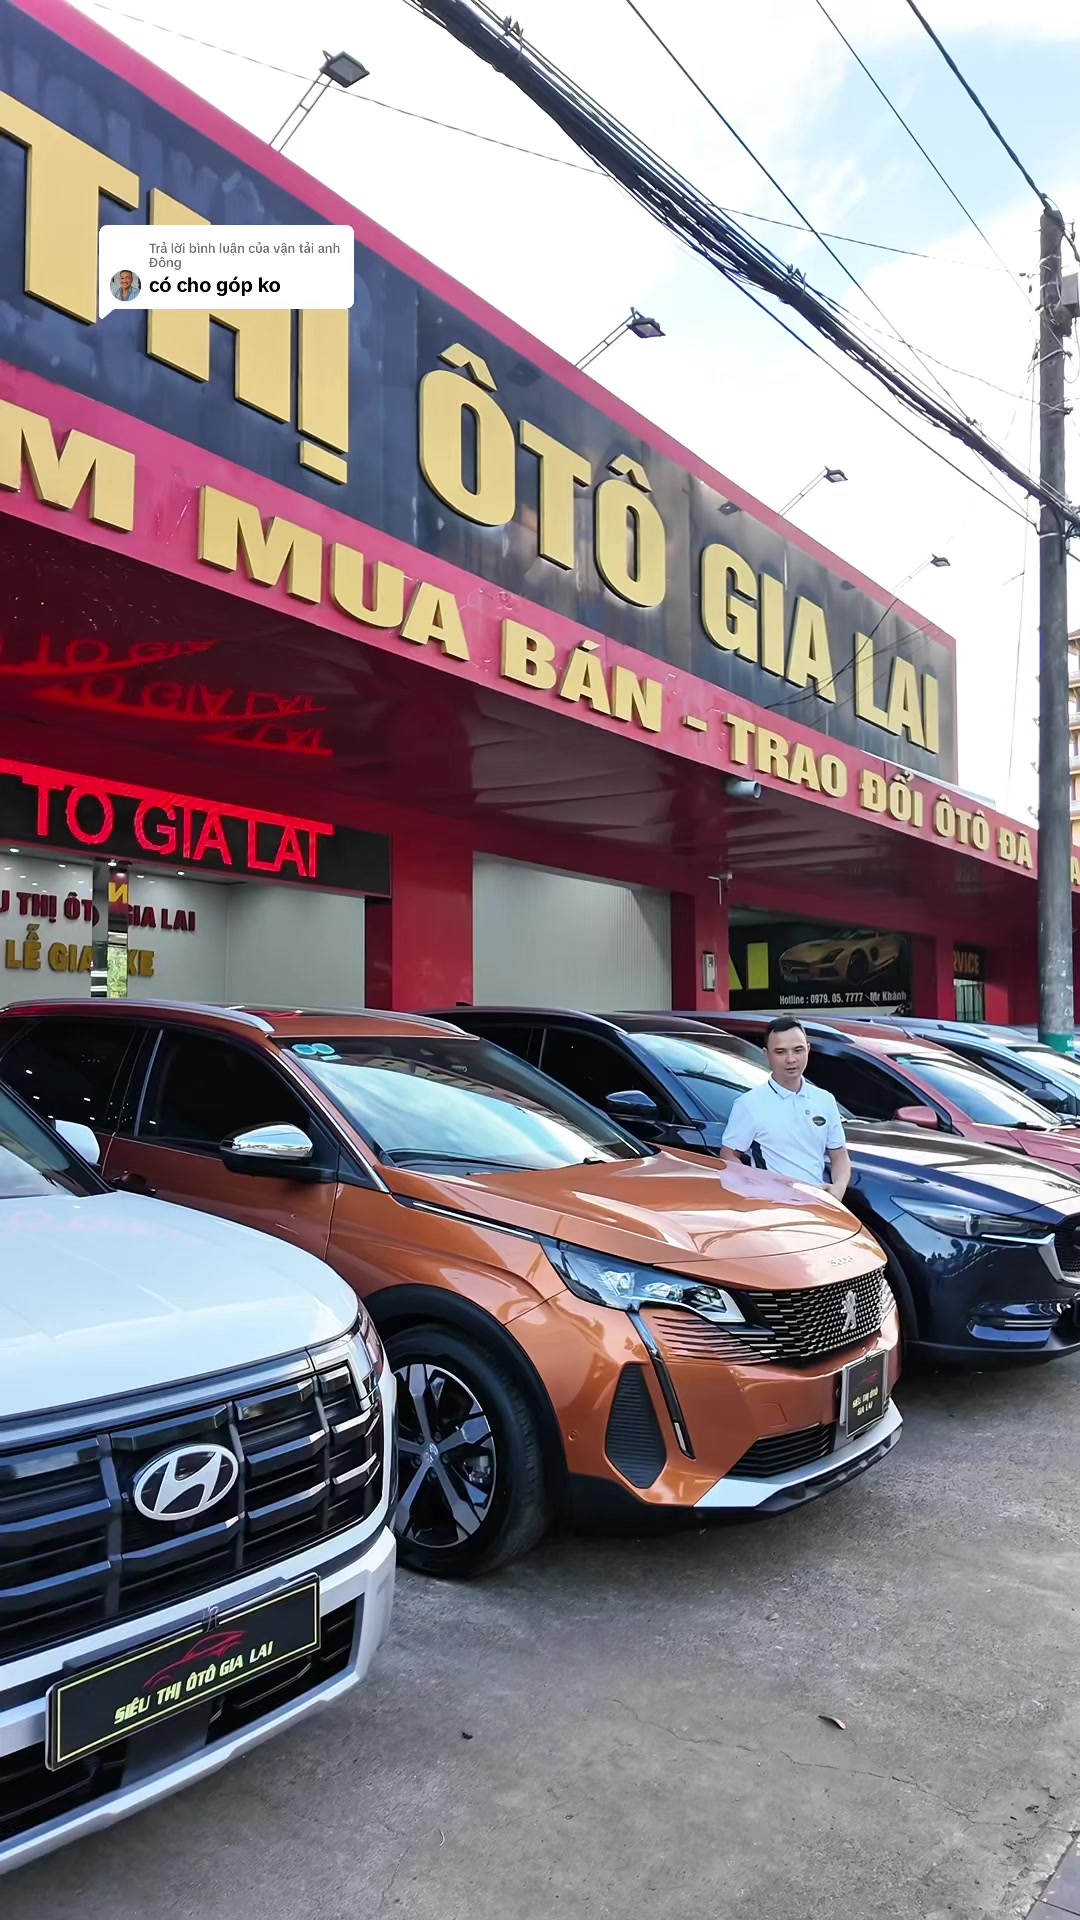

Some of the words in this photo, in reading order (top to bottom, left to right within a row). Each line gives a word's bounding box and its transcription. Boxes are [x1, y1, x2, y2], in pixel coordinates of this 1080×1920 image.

[419, 343, 667, 608] ÔTÔ
[701, 543, 836, 704] GIA
[854, 632, 940, 755] LAI
[198, 485, 470, 661] MUA
[500, 618, 663, 733] BÁN
[724, 713, 847, 799] TRAO
[859, 771, 923, 828] ĐỔI
[934, 793, 990, 851] ÔTÔ
[134, 798, 232, 865] GIA
[16, 892, 57, 923] THỊ
[161, 909, 196, 931] LAI
[779, 995, 805, 1006] Hotline
[810, 994, 830, 1004] 0979.
[832, 993, 844, 1004] 05.
[845, 992, 864, 1003] 7777
[870, 991, 880, 1001] Mr
[114, 1695, 151, 1724] SIÊU
[157, 1681, 182, 1705] THỊ
[186, 1663, 216, 1692] ÔTÔ
[219, 1654, 243, 1676] GIA
[249, 1641, 274, 1663] LAI
